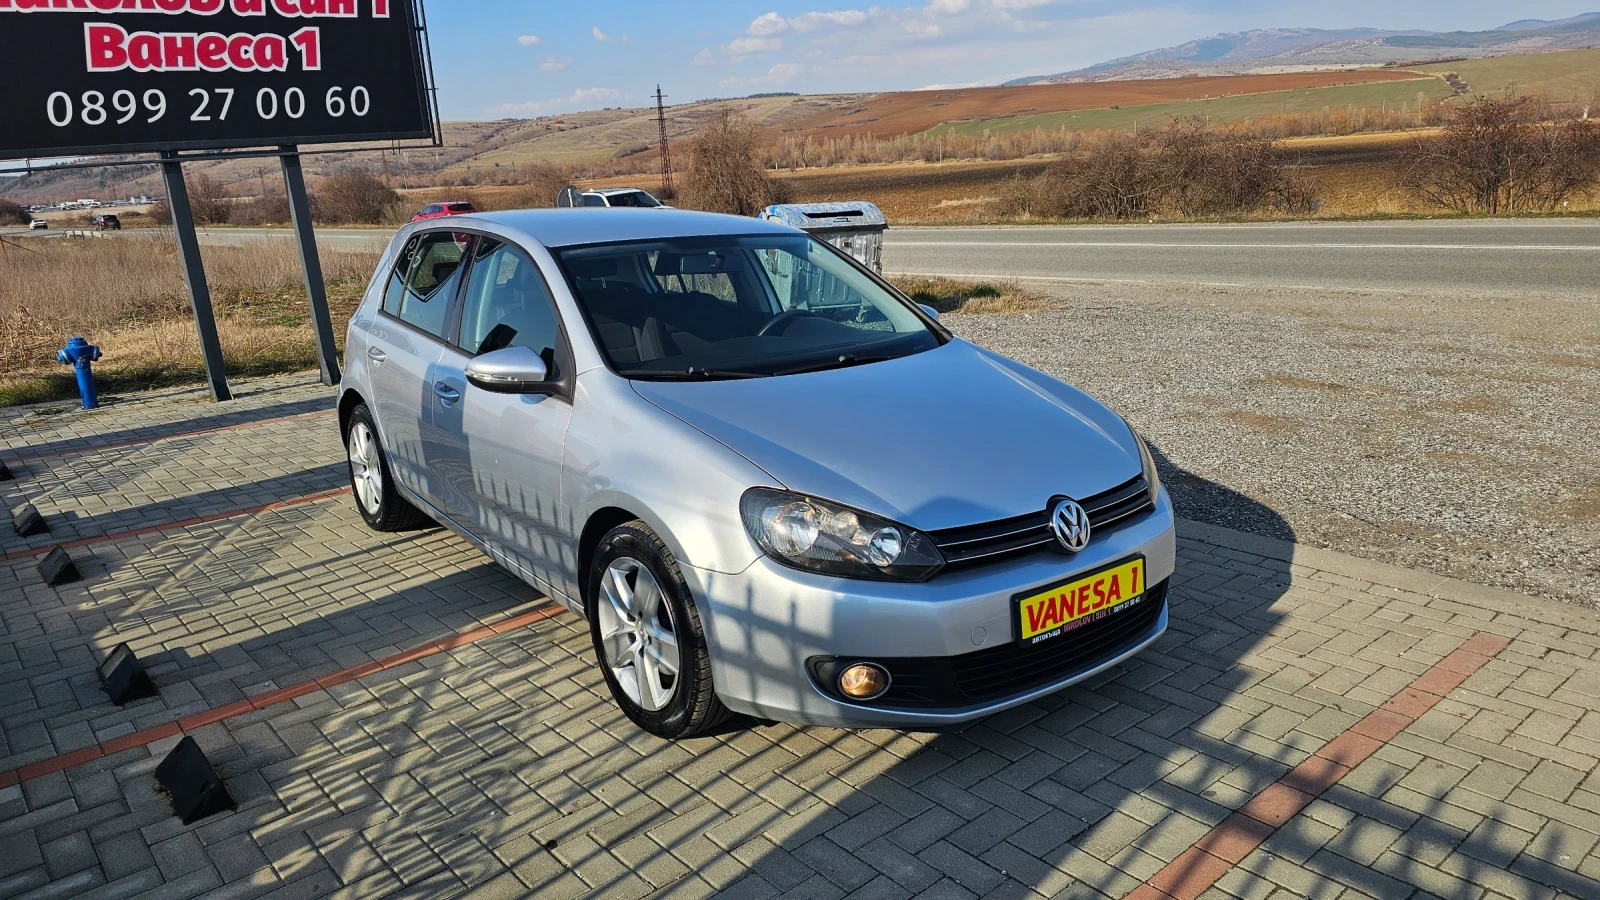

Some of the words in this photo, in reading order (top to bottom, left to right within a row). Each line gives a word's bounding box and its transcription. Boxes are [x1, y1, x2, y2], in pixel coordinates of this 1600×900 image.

[84, 22, 288, 72] Ванеса
[288, 26, 321, 71] 1
[46, 88, 168, 127] 0899
[187, 87, 235, 122] 27
[255, 86, 306, 120] 00
[324, 85, 371, 118] 60
[1026, 573, 1122, 633] VANESA
[1131, 566, 1139, 594] 1
